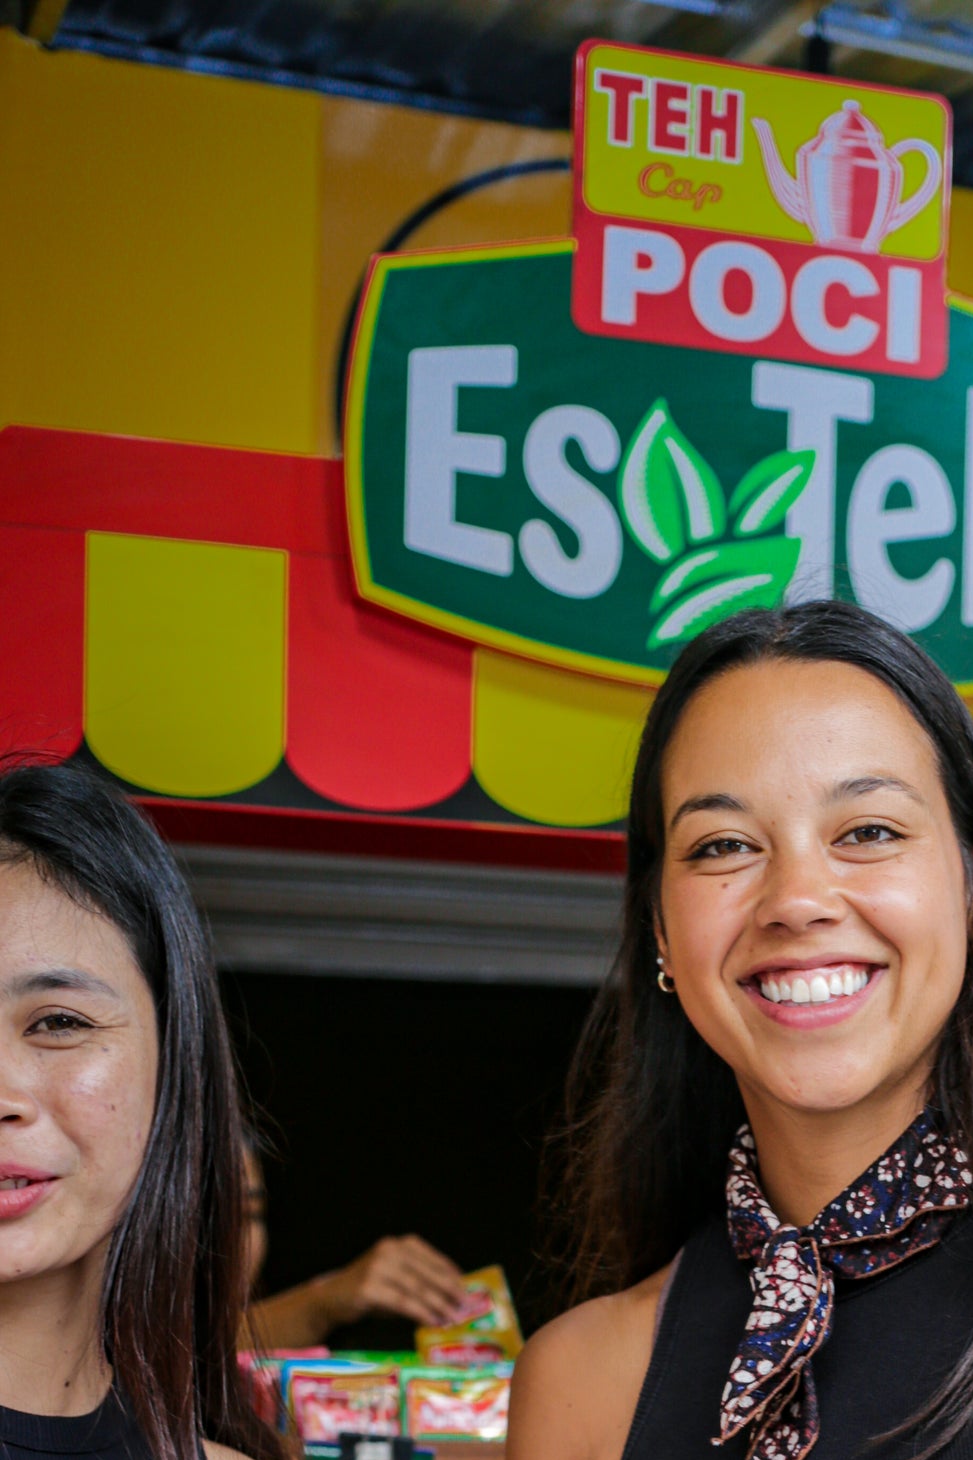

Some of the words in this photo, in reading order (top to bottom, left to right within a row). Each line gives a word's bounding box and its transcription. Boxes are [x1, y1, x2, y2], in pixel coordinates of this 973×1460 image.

[594, 68, 744, 165] TEH
[638, 161, 722, 211] Cap
[601, 224, 922, 364] POCI
[403, 345, 623, 599] Es
